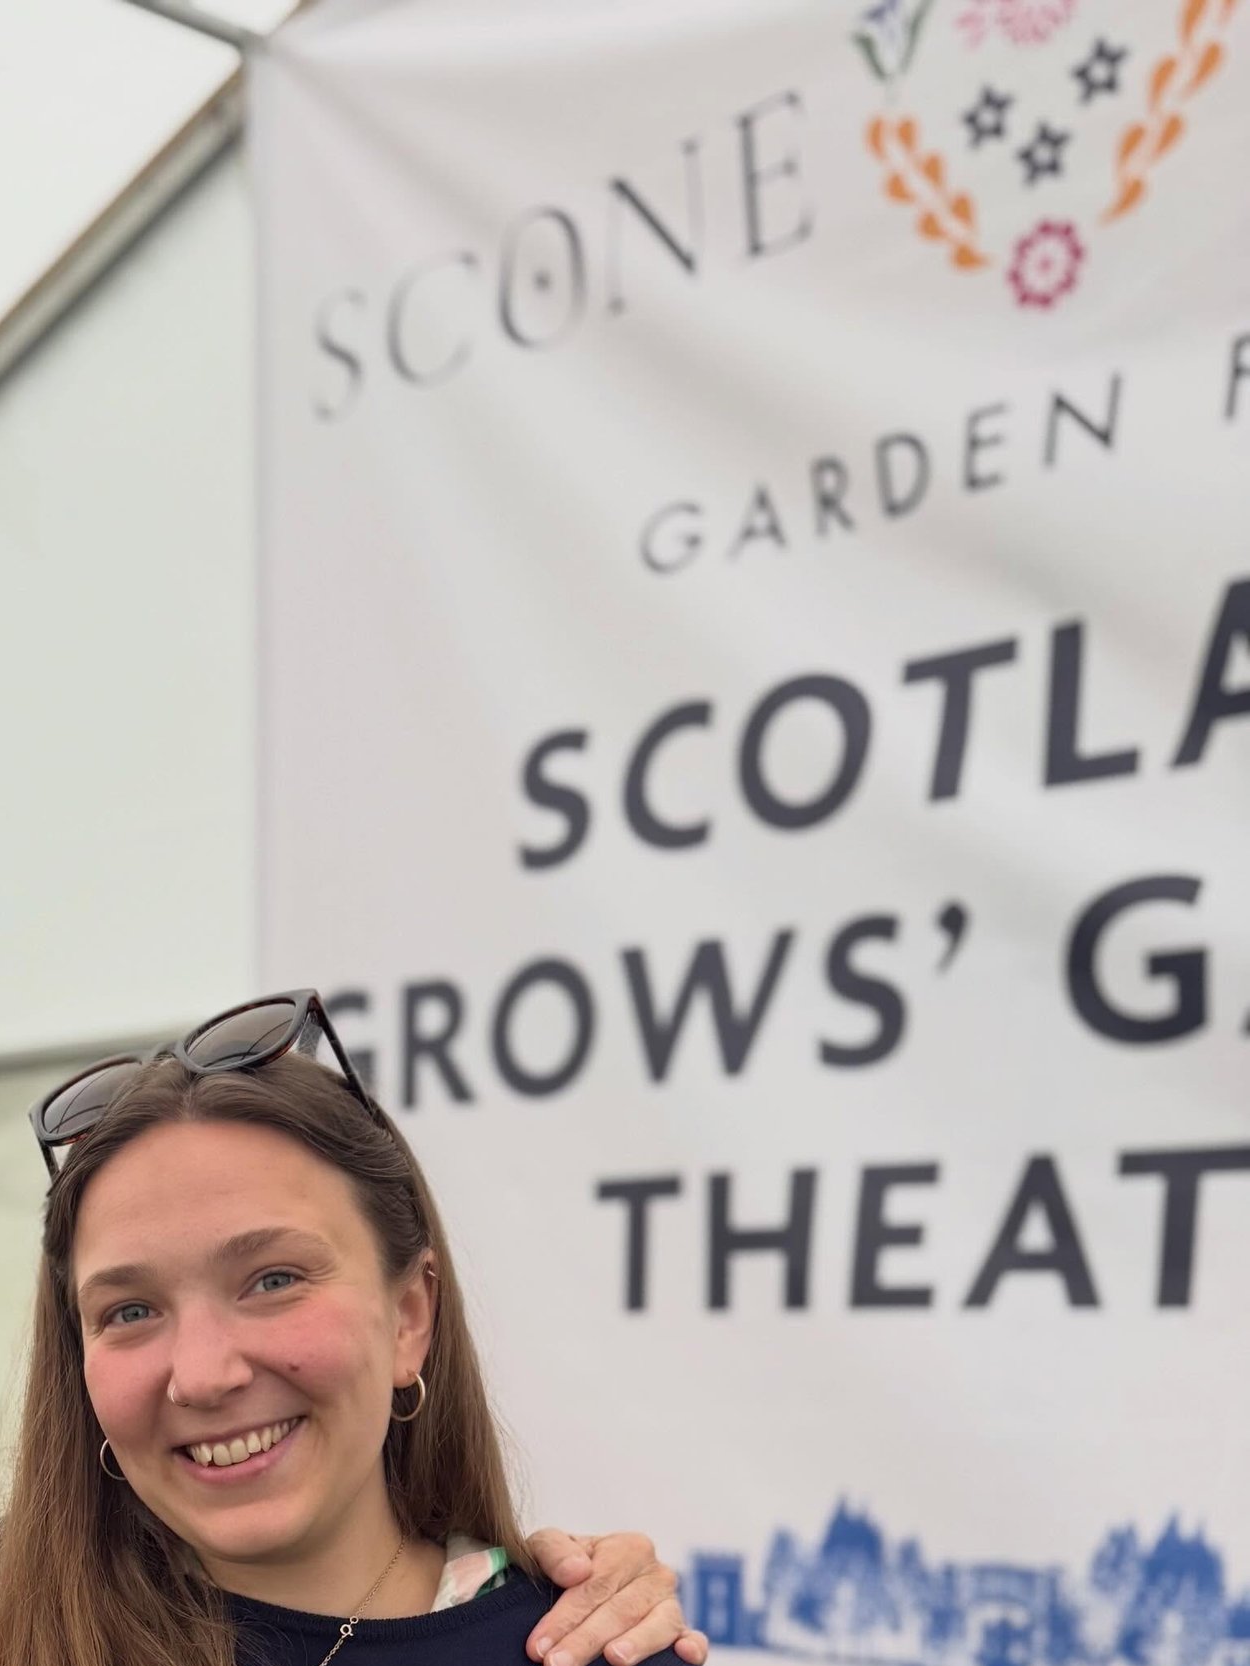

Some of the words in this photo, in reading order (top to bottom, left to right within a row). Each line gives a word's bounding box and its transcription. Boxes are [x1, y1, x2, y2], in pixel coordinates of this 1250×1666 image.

[314, 88, 816, 424] SCONE
[638, 372, 1124, 575] GARDEN
[518, 574, 1250, 873] SCOTLA
[1062, 873, 1250, 1050] G
[594, 1142, 1250, 1314] THEAT
